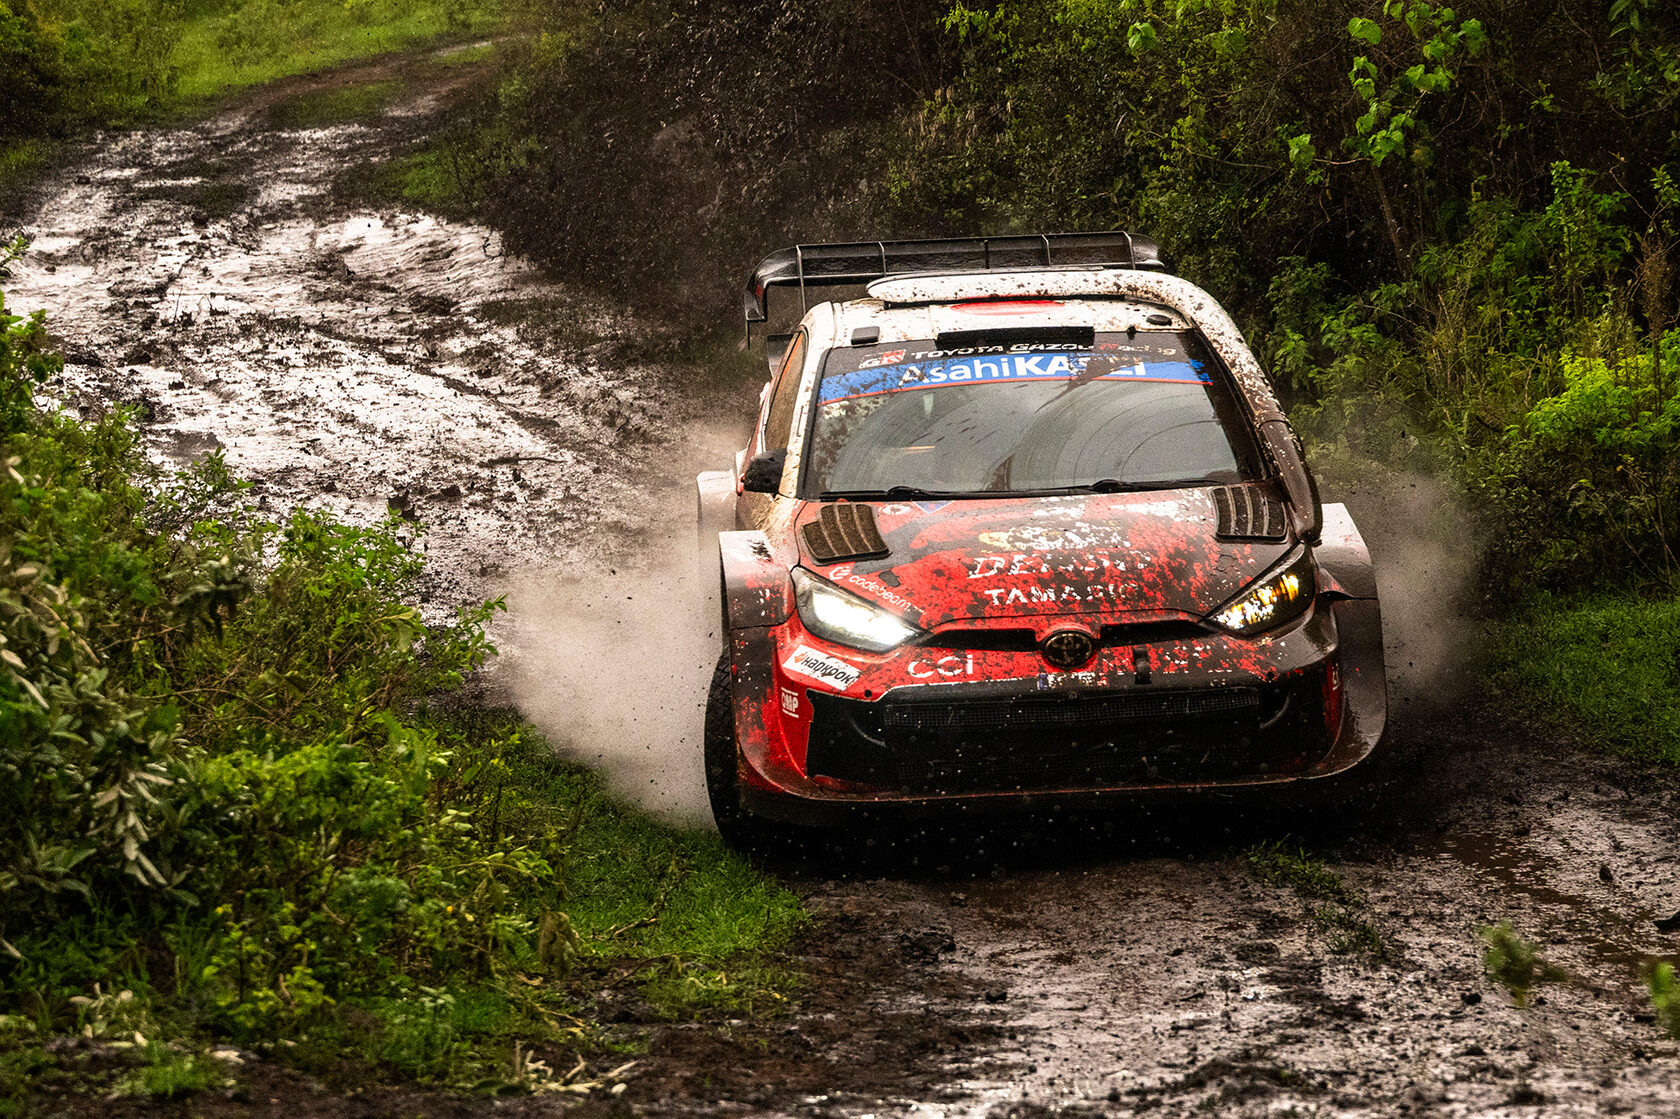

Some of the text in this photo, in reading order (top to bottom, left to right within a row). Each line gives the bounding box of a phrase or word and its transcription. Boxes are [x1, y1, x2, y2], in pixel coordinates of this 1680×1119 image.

[911, 345, 1003, 360] TOYOTA
[898, 355, 1147, 386] Asahi KAI
